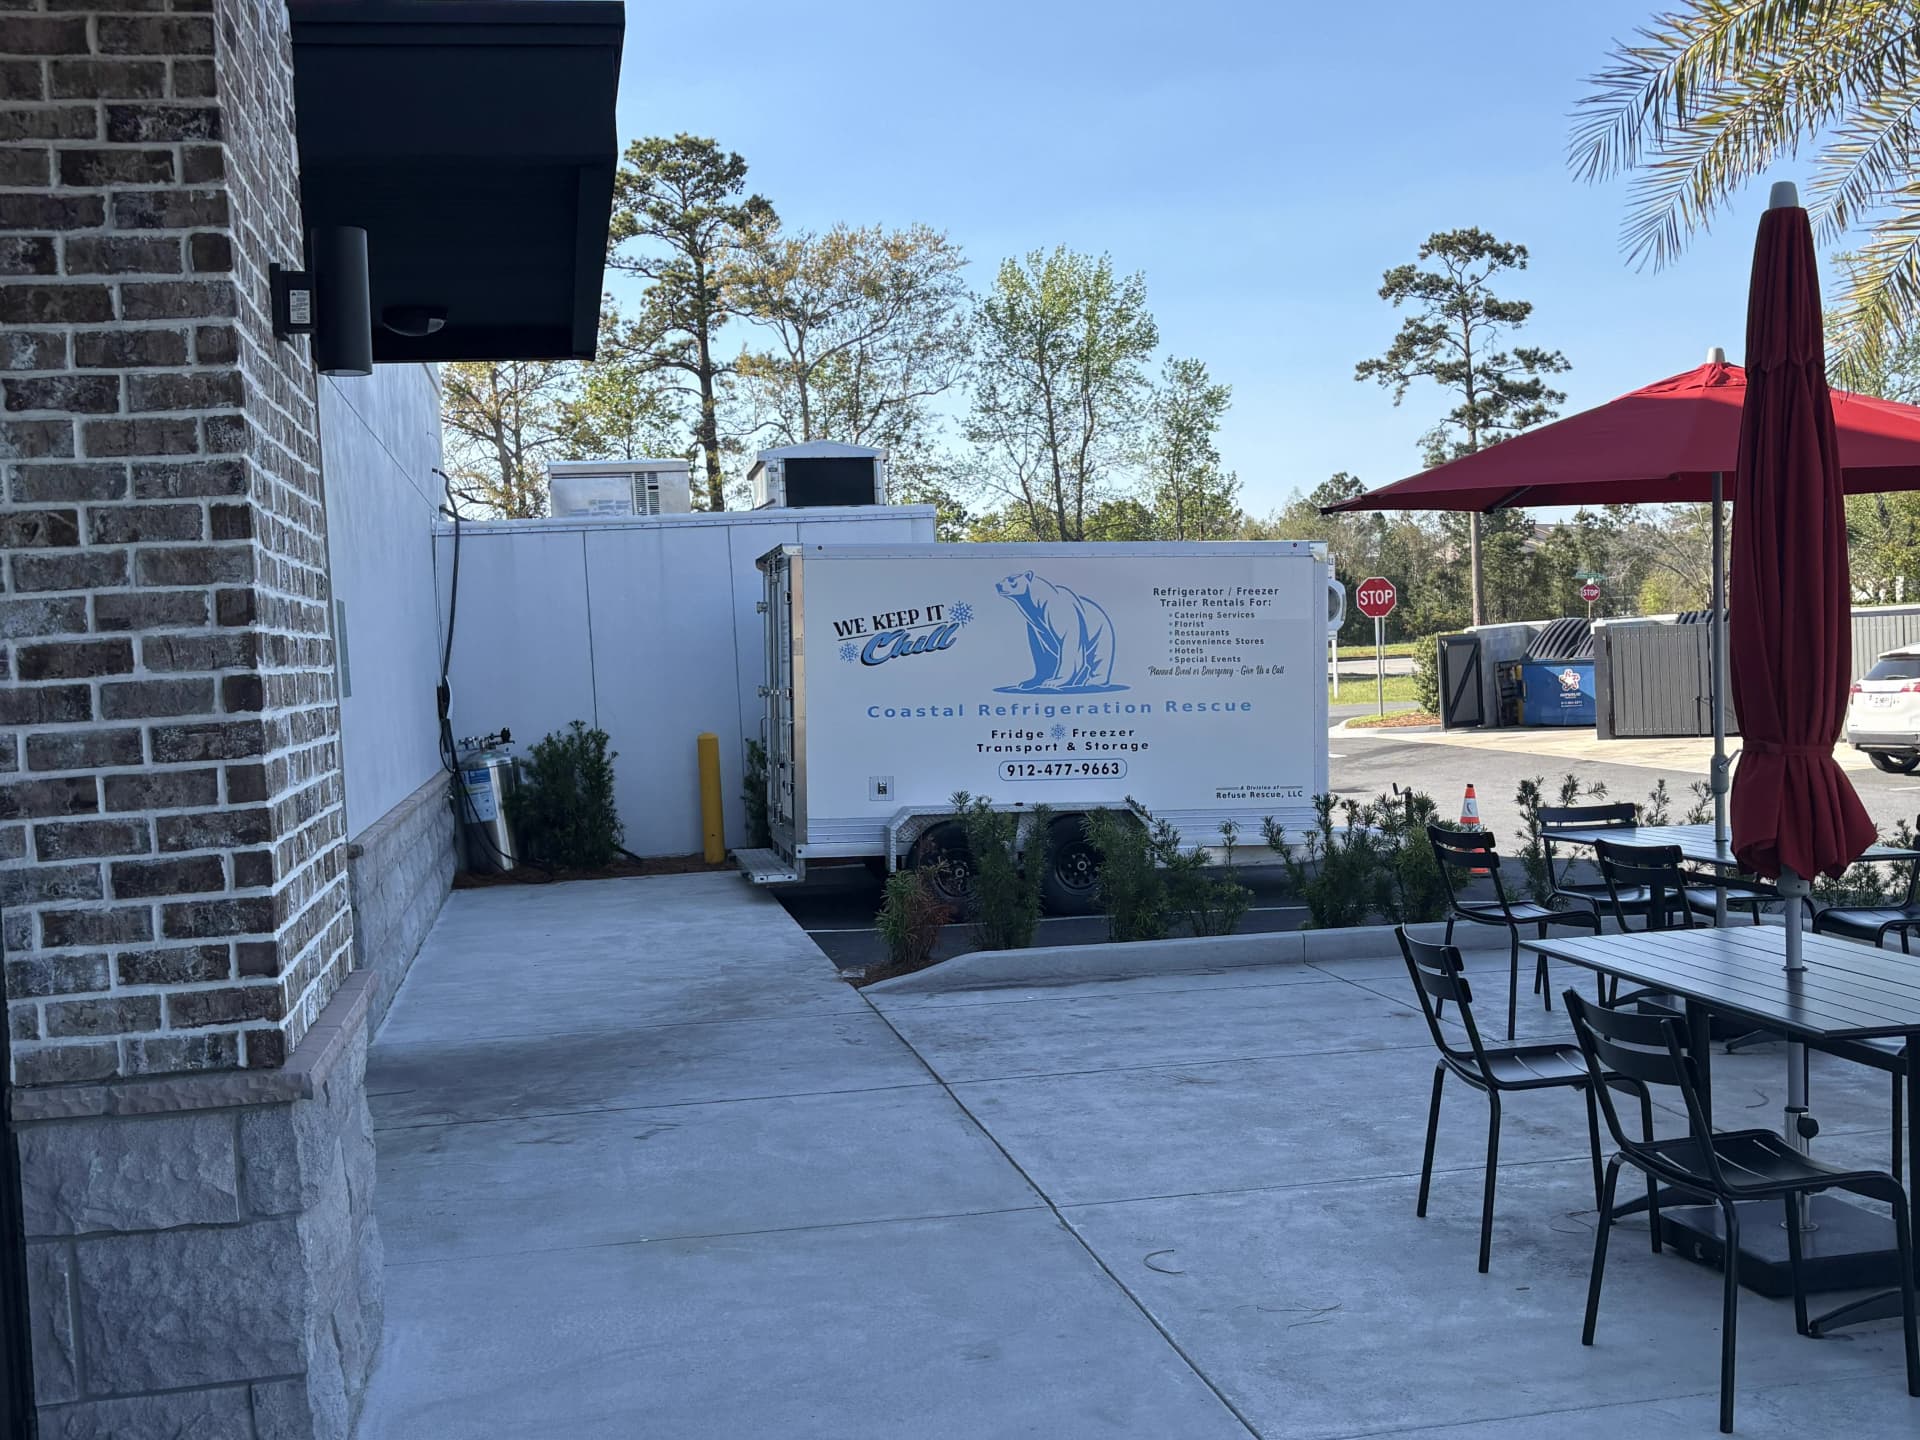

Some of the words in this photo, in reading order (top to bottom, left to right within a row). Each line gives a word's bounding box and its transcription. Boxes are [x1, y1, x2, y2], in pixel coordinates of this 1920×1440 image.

[1153, 587, 1224, 598] Refrigerator
[1236, 586, 1280, 596] Freezer
[1583, 588, 1599, 598] STOP
[1160, 598, 1198, 607] Trailer
[1202, 598, 1245, 607] Rentals
[1249, 598, 1272, 607] For:
[1360, 590, 1394, 606] STOP
[833, 617, 867, 637] WE
[872, 608, 920, 631] KEEP
[926, 604, 945, 622] IT
[1174, 611, 1213, 620] Catering
[1216, 610, 1255, 619] Services
[1174, 620, 1205, 628] Florist
[1174, 629, 1230, 637] Restaurants
[860, 622, 960, 667] Chill
[1174, 638, 1232, 646] Convenience
[1235, 637, 1265, 645] Stores
[1174, 646, 1204, 655] Hotels
[1174, 655, 1208, 664] Special
[1211, 655, 1241, 663] Events
[1201, 666, 1234, 677] Emergency
[1271, 664, 1285, 675] Call
[867, 704, 964, 719] Coastal
[978, 701, 1151, 719] Refrigeration
[1165, 700, 1252, 713] Rescue
[991, 729, 1045, 741] Fridge
[1072, 728, 1135, 738] Freezer
[977, 743, 1058, 754] Transport
[1066, 742, 1076, 751] &
[1085, 741, 1149, 752] Storage
[1007, 762, 1120, 777] 912-477-9663
[1216, 791, 1247, 799] Refuse
[1249, 790, 1284, 799] Rescue,
[1287, 790, 1303, 798] LLC
